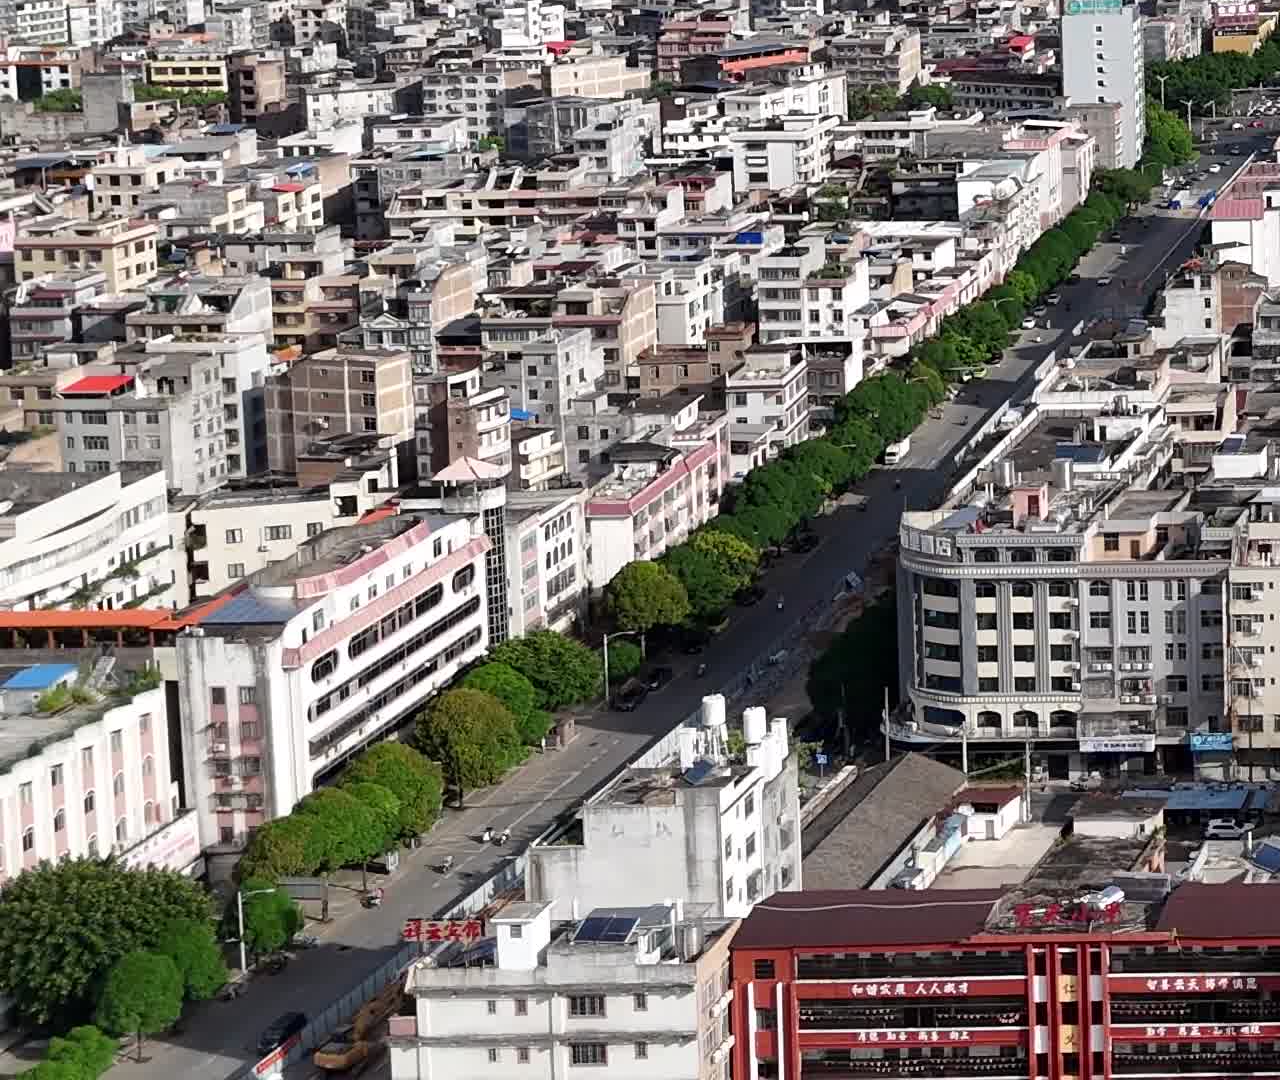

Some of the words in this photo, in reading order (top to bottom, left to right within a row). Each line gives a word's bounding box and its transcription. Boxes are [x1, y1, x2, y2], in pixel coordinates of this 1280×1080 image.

[401, 919, 481, 941] 祥云宾馆
[851, 983, 906, 996] 和谐发展
[914, 982, 969, 995] 人人成才
